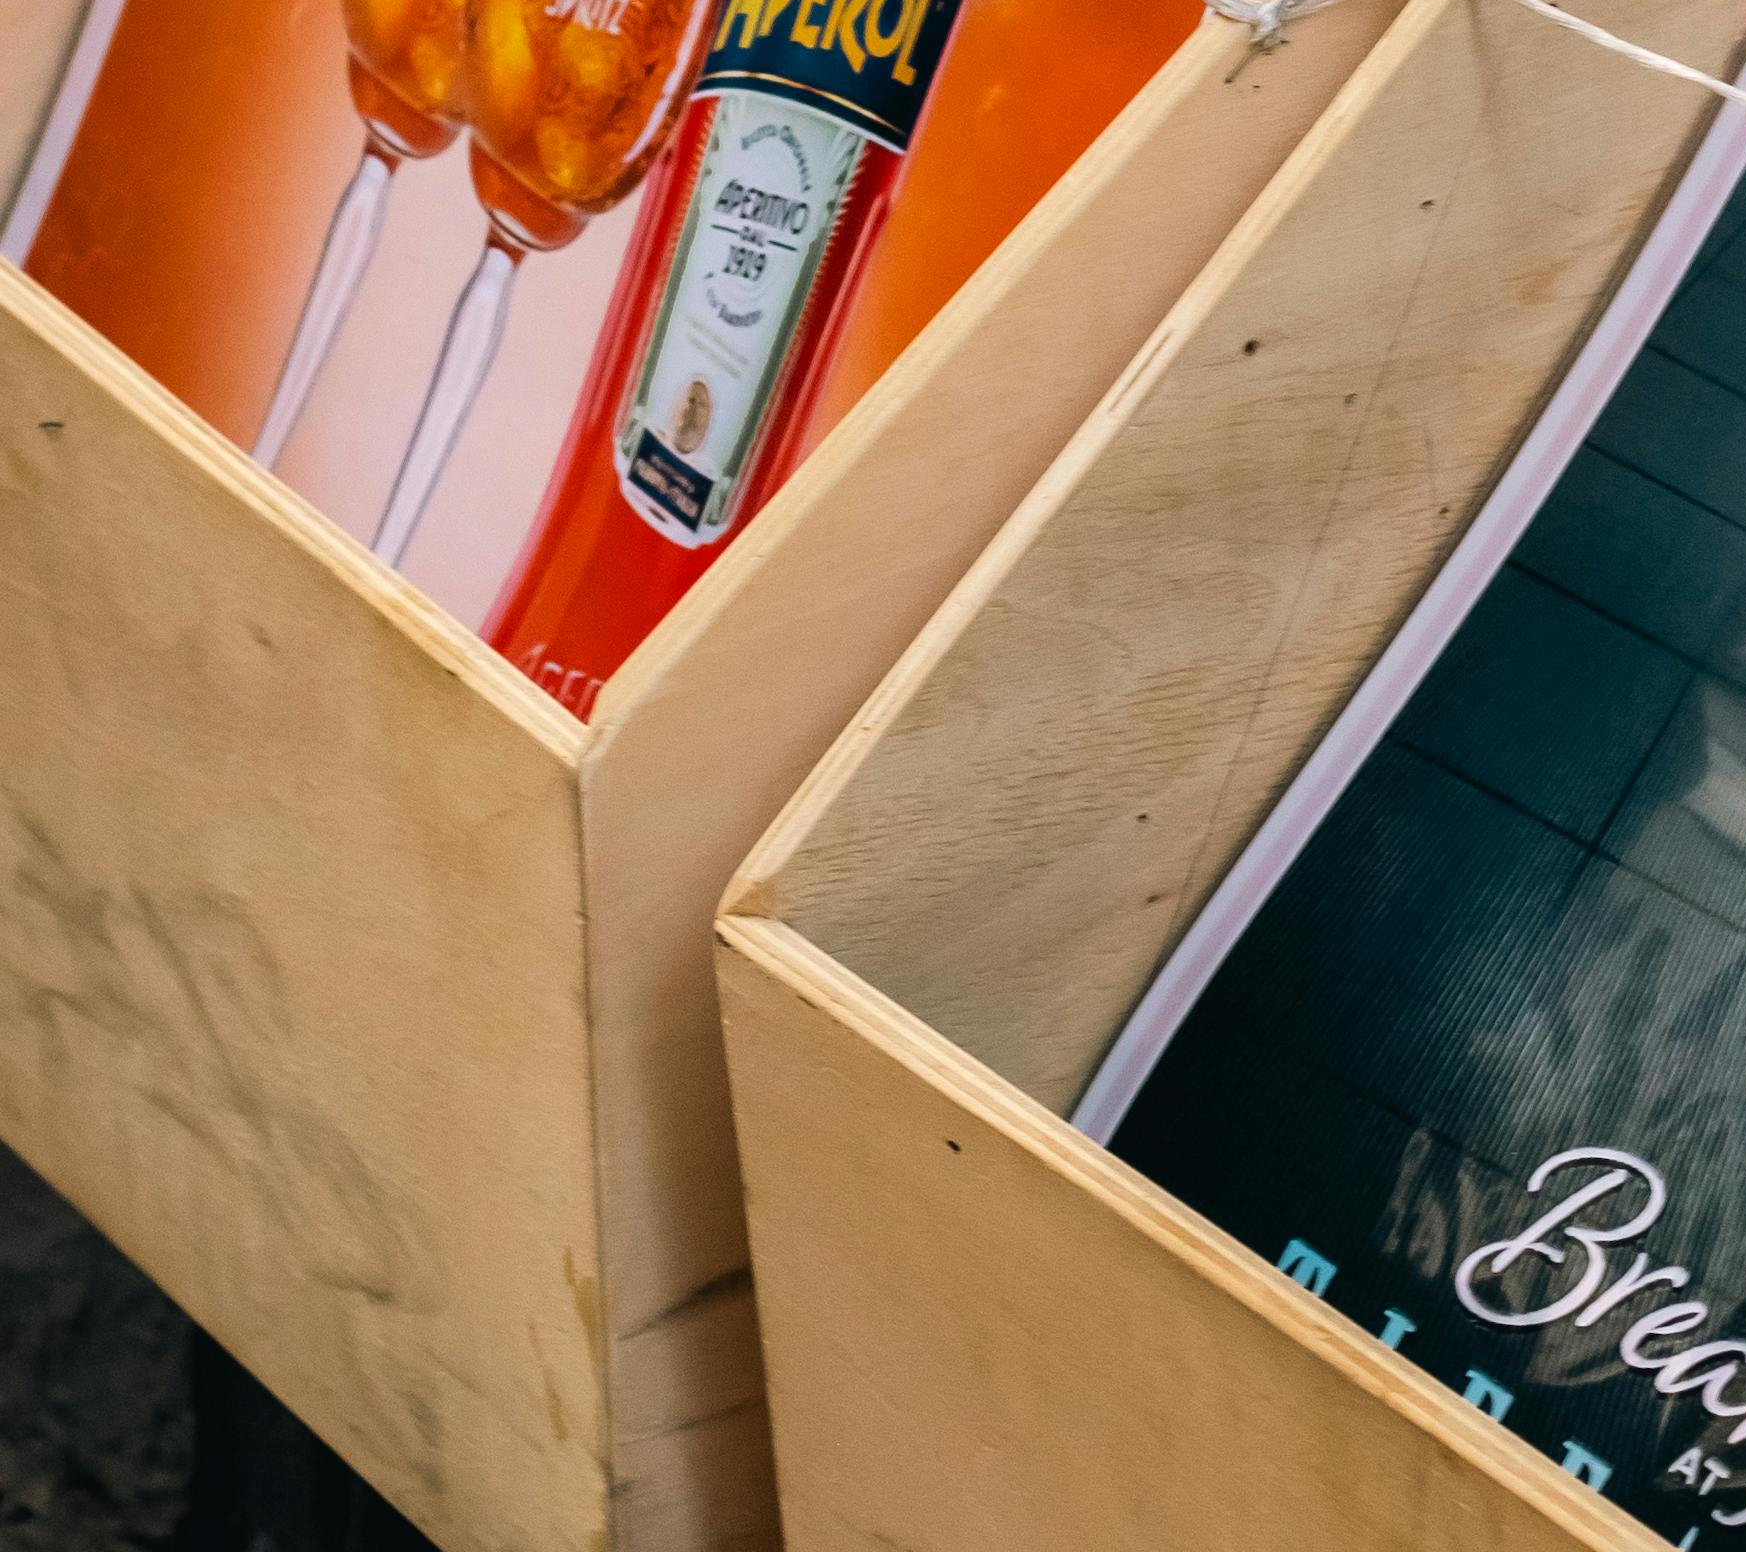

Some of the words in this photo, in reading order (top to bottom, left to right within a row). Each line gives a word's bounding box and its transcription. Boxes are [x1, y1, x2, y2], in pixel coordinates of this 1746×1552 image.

[713, 179, 810, 235] APERITIVO
[722, 245, 767, 282] 1919
[1668, 1446, 1731, 1496] AT
